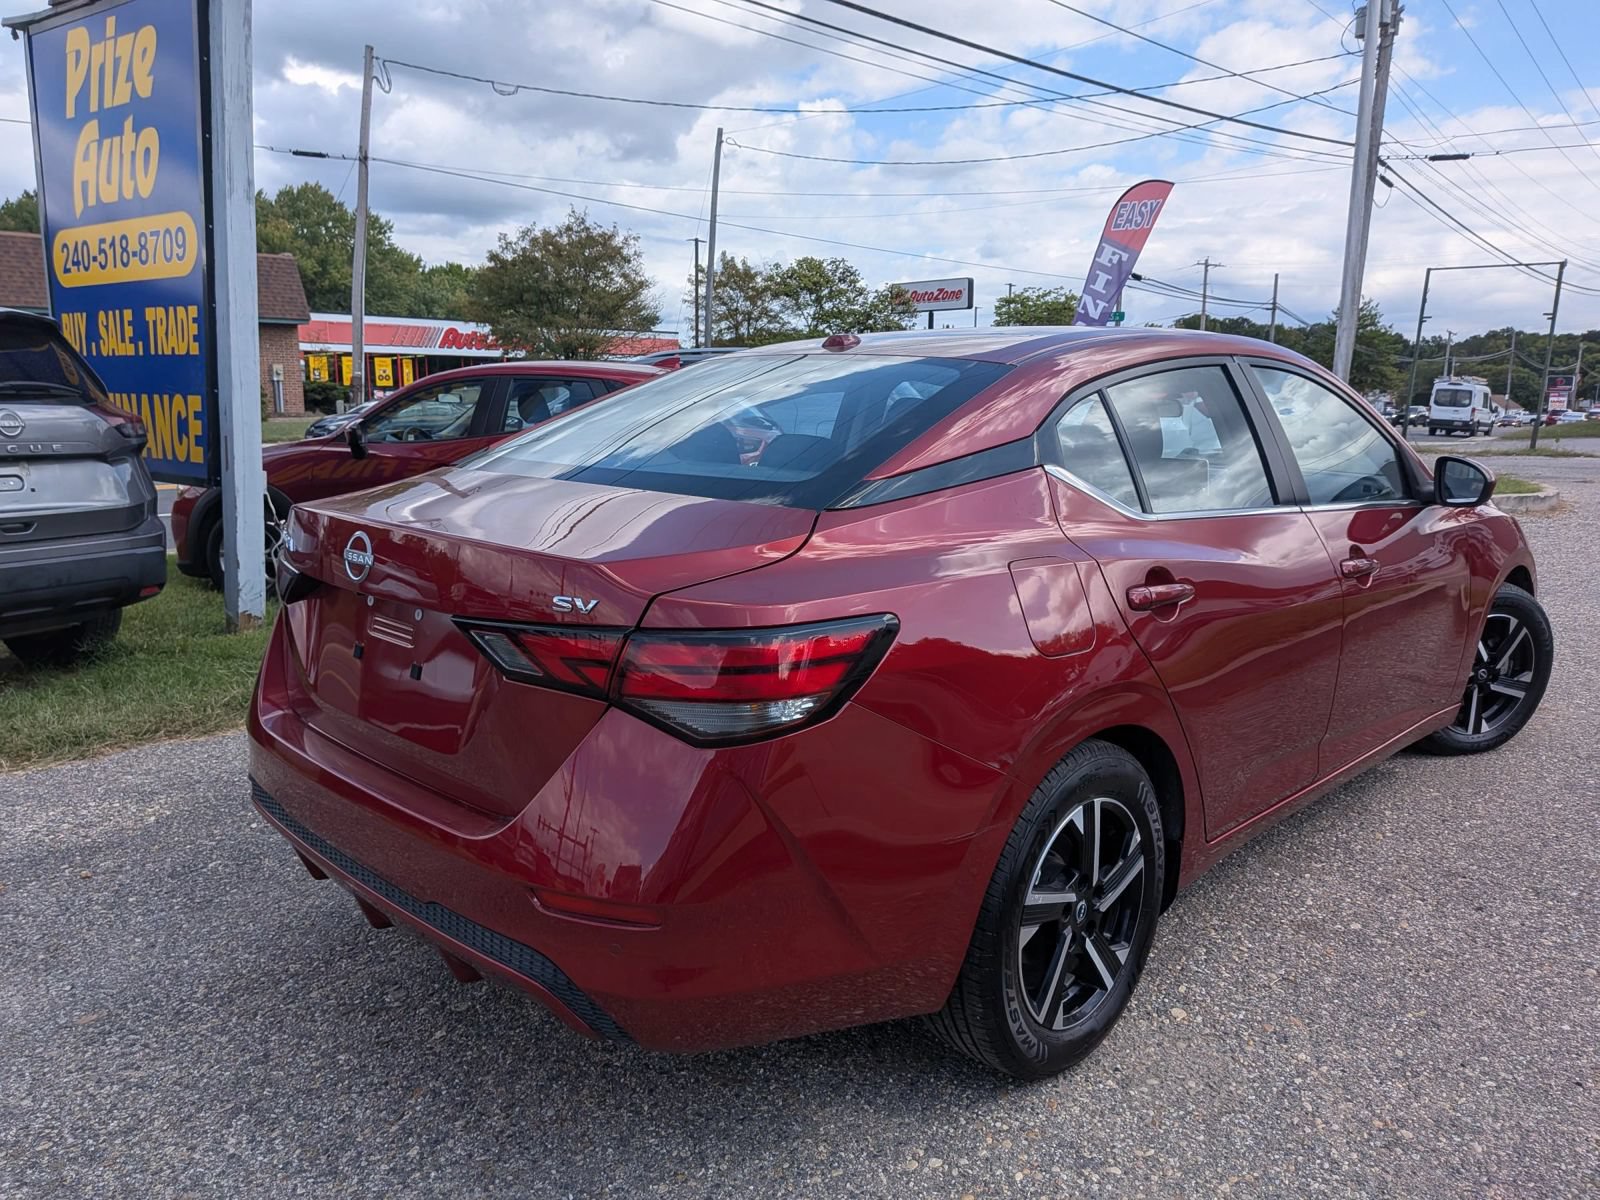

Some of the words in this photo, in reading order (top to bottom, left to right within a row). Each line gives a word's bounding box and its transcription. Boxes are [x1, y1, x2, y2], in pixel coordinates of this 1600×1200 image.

[65, 15, 157, 120] Prize
[73, 114, 160, 220] Auto
[1111, 198, 1163, 231] EASY
[60, 225, 187, 275] 240-518-8709
[909, 287, 964, 304] AutoZone
[1077, 242, 1129, 325] FIN
[61, 311, 87, 357] BUY
[98, 308, 135, 357] SALE
[145, 304, 200, 356] TRADE
[6, 443, 65, 454] GUE
[551, 595, 601, 615] SV
